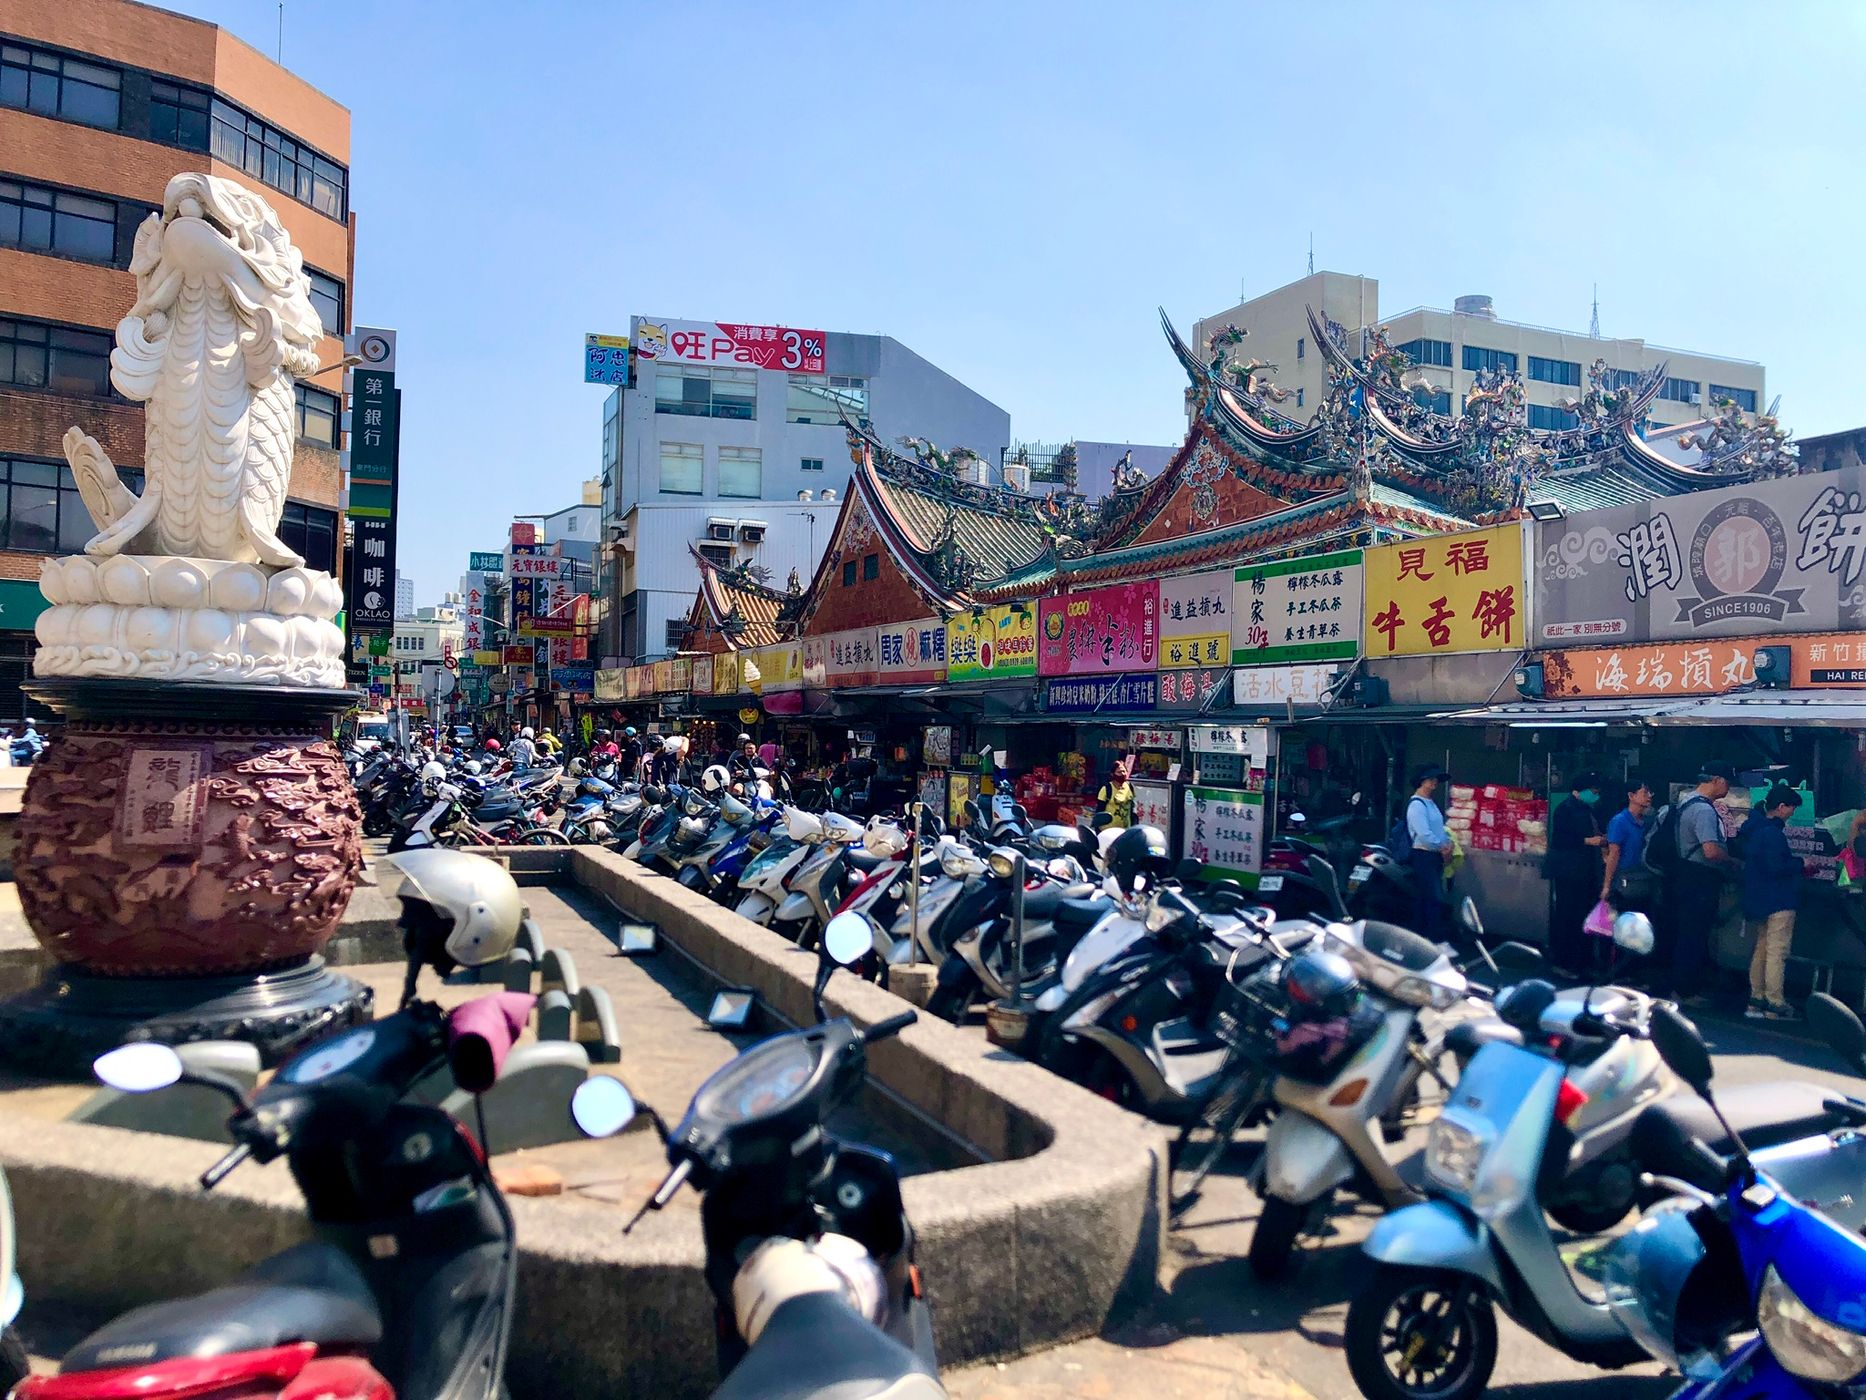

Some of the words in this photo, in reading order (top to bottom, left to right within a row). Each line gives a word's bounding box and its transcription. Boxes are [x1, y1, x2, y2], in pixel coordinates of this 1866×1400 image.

[588, 346, 626, 367] 阿忠
[733, 326, 778, 342] 消費享
[780, 331, 823, 369] 3%
[363, 377, 383, 447] 第一銀行
[1617, 512, 1683, 602] 潤
[1796, 485, 1866, 587] 餅
[363, 538, 386, 588] 咖啡
[511, 558, 559, 574] 元寶銀樓
[1287, 570, 1344, 592] 檸檬冬瓜露
[1250, 570, 1267, 625] 楊家
[1286, 596, 1342, 617] 手工冬瓜茶
[355, 609, 391, 619] OKLAO
[1371, 584, 1516, 652] 牛舌餅
[1704, 602, 1772, 619] SINCE1906
[467, 588, 483, 658] 金和成銀
[1143, 598, 1154, 657] 裕進行
[1284, 622, 1341, 642] 養生青草茶
[1584, 620, 1622, 635] 別無分號
[1170, 640, 1220, 665] 裕進號
[1827, 671, 1845, 681] HAI
[1210, 729, 1248, 746] 檸檬冬露
